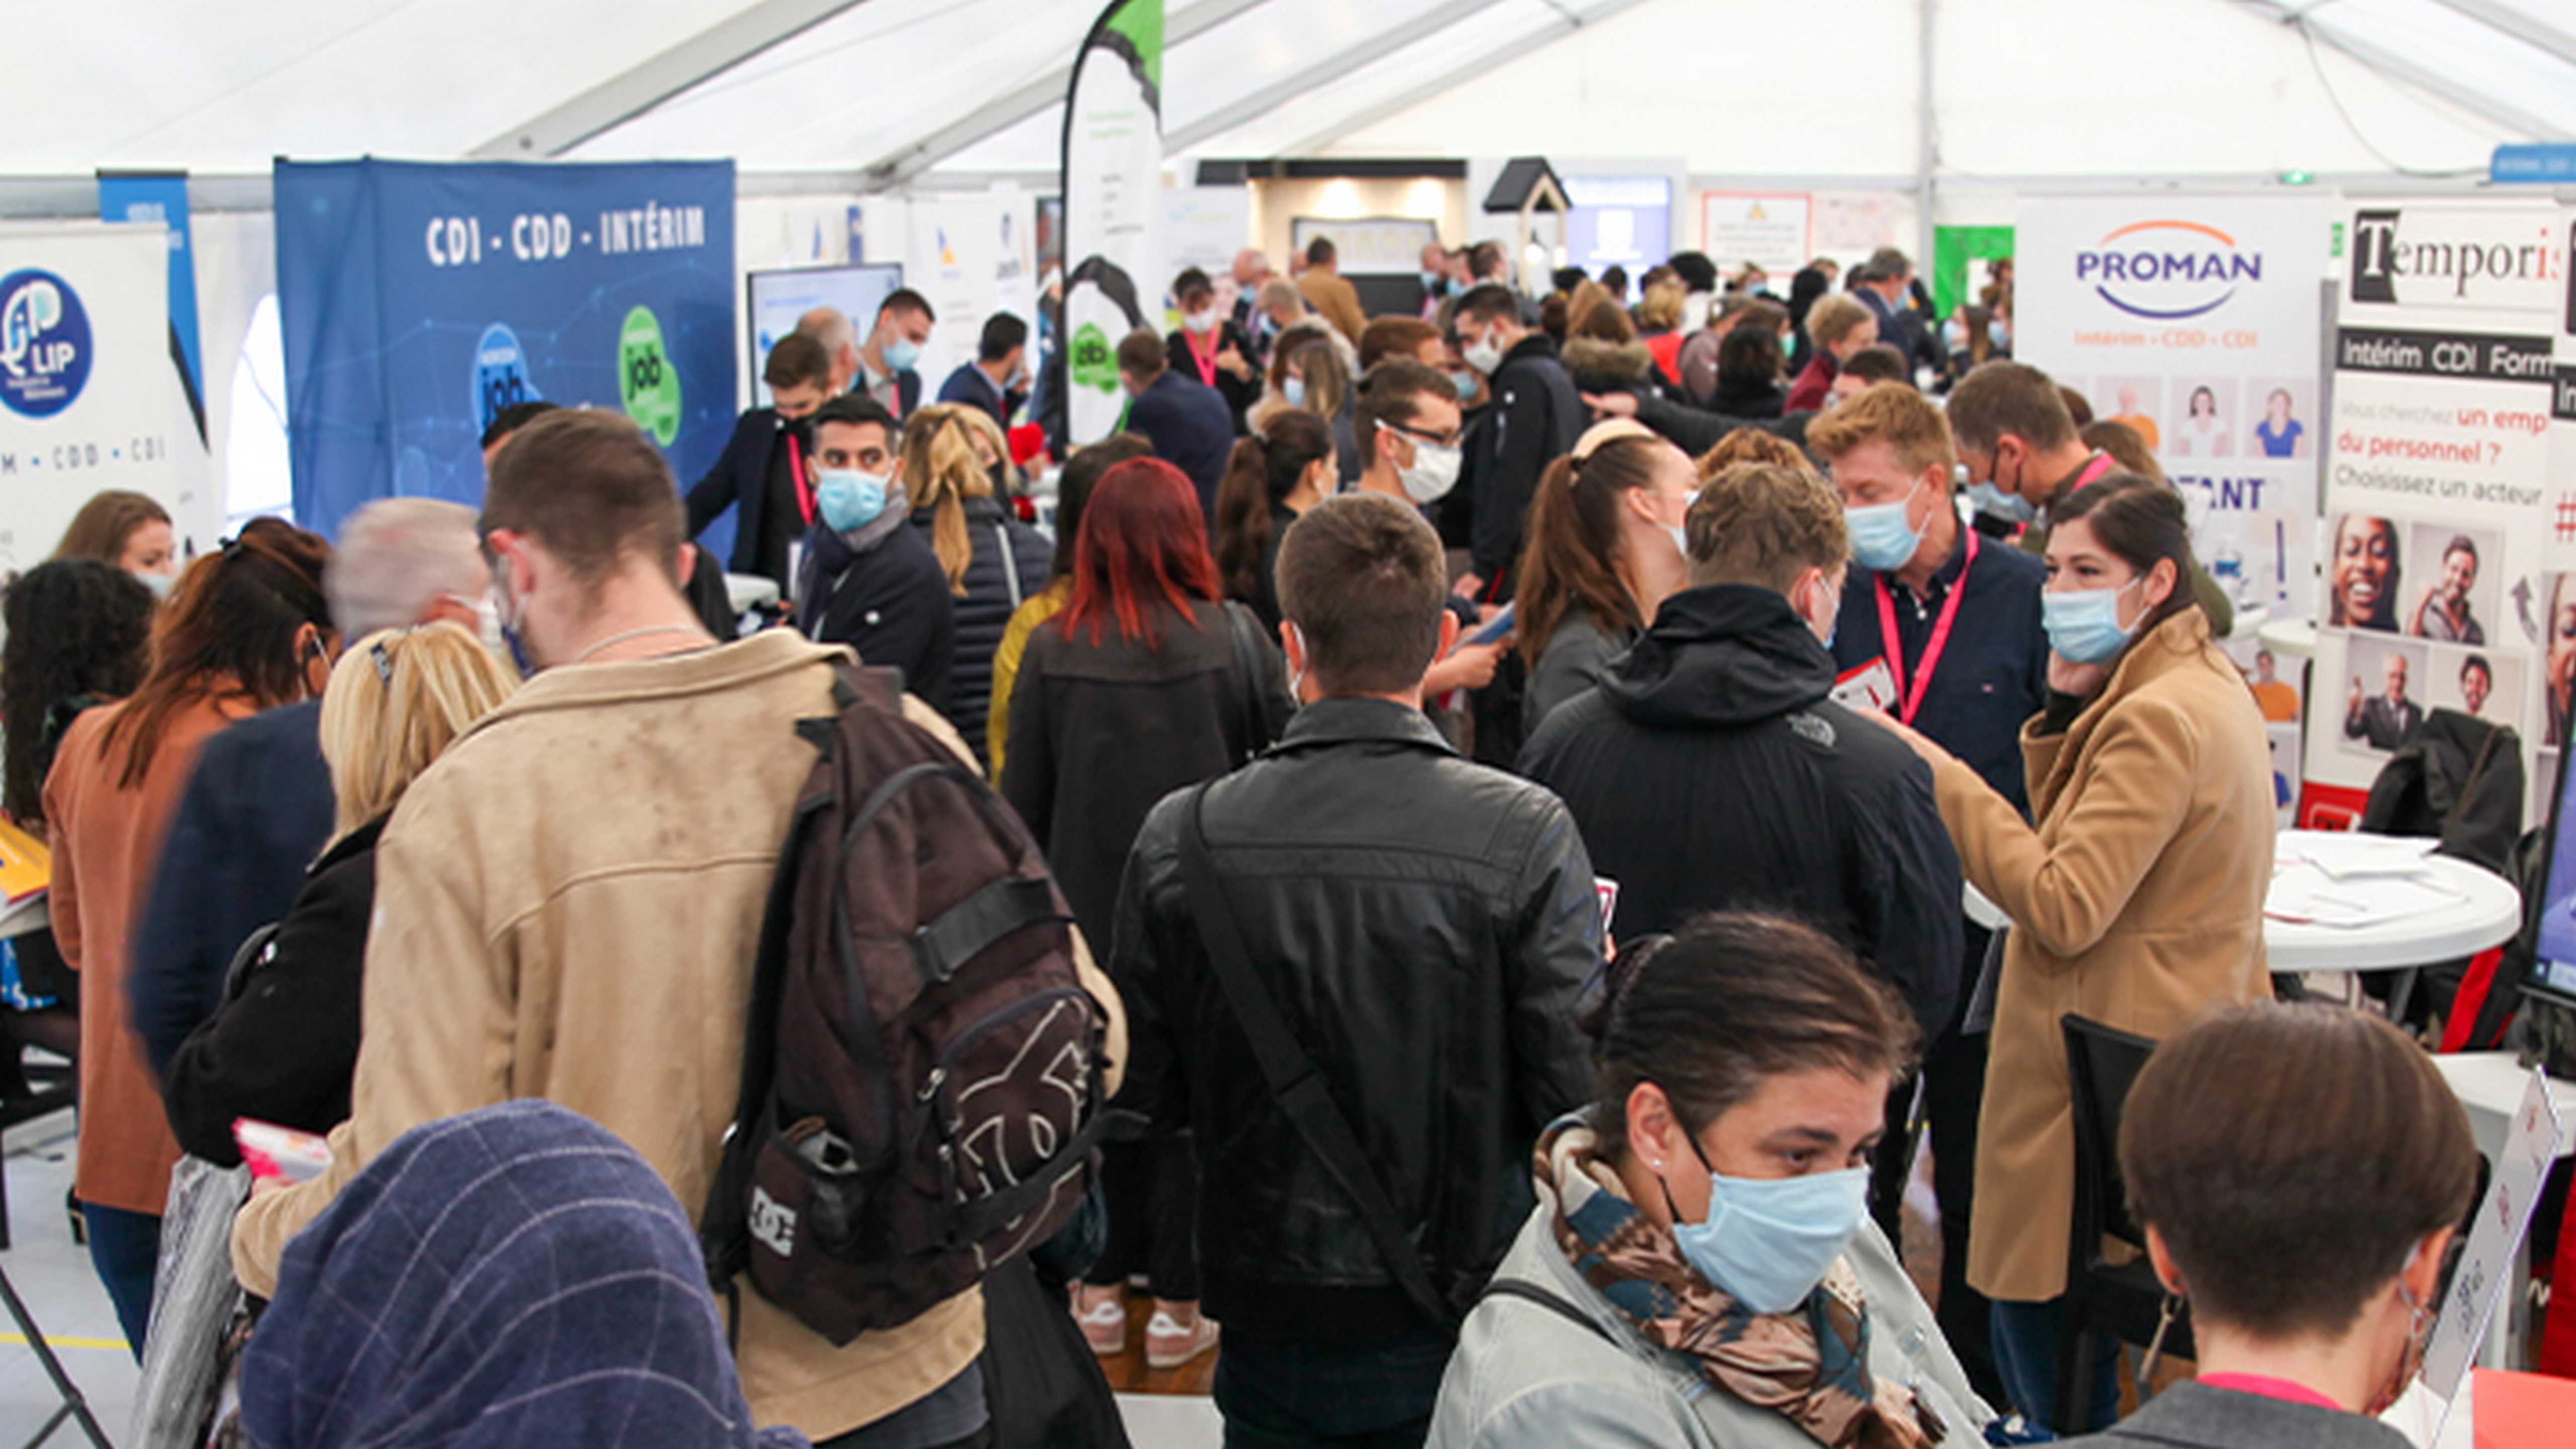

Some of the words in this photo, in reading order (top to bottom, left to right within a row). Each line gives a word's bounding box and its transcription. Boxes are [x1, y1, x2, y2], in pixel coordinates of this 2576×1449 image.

[427, 218, 481, 266] CDI
[512, 213, 572, 261] CDD
[601, 200, 704, 254] INTÉRIM
[2076, 252, 2262, 281] PROMAN
[32, 342, 75, 374] LIP
[2343, 338, 2423, 369] Intérim
[2432, 341, 2477, 372] CDI
[625, 344, 663, 402] job
[2457, 409, 2488, 427] un
[2337, 429, 2363, 453] du
[2369, 436, 2482, 463] personnel
[2336, 464, 2435, 495] Choisissez
[2440, 478, 2466, 497] un
[2473, 483, 2543, 505] acteur
